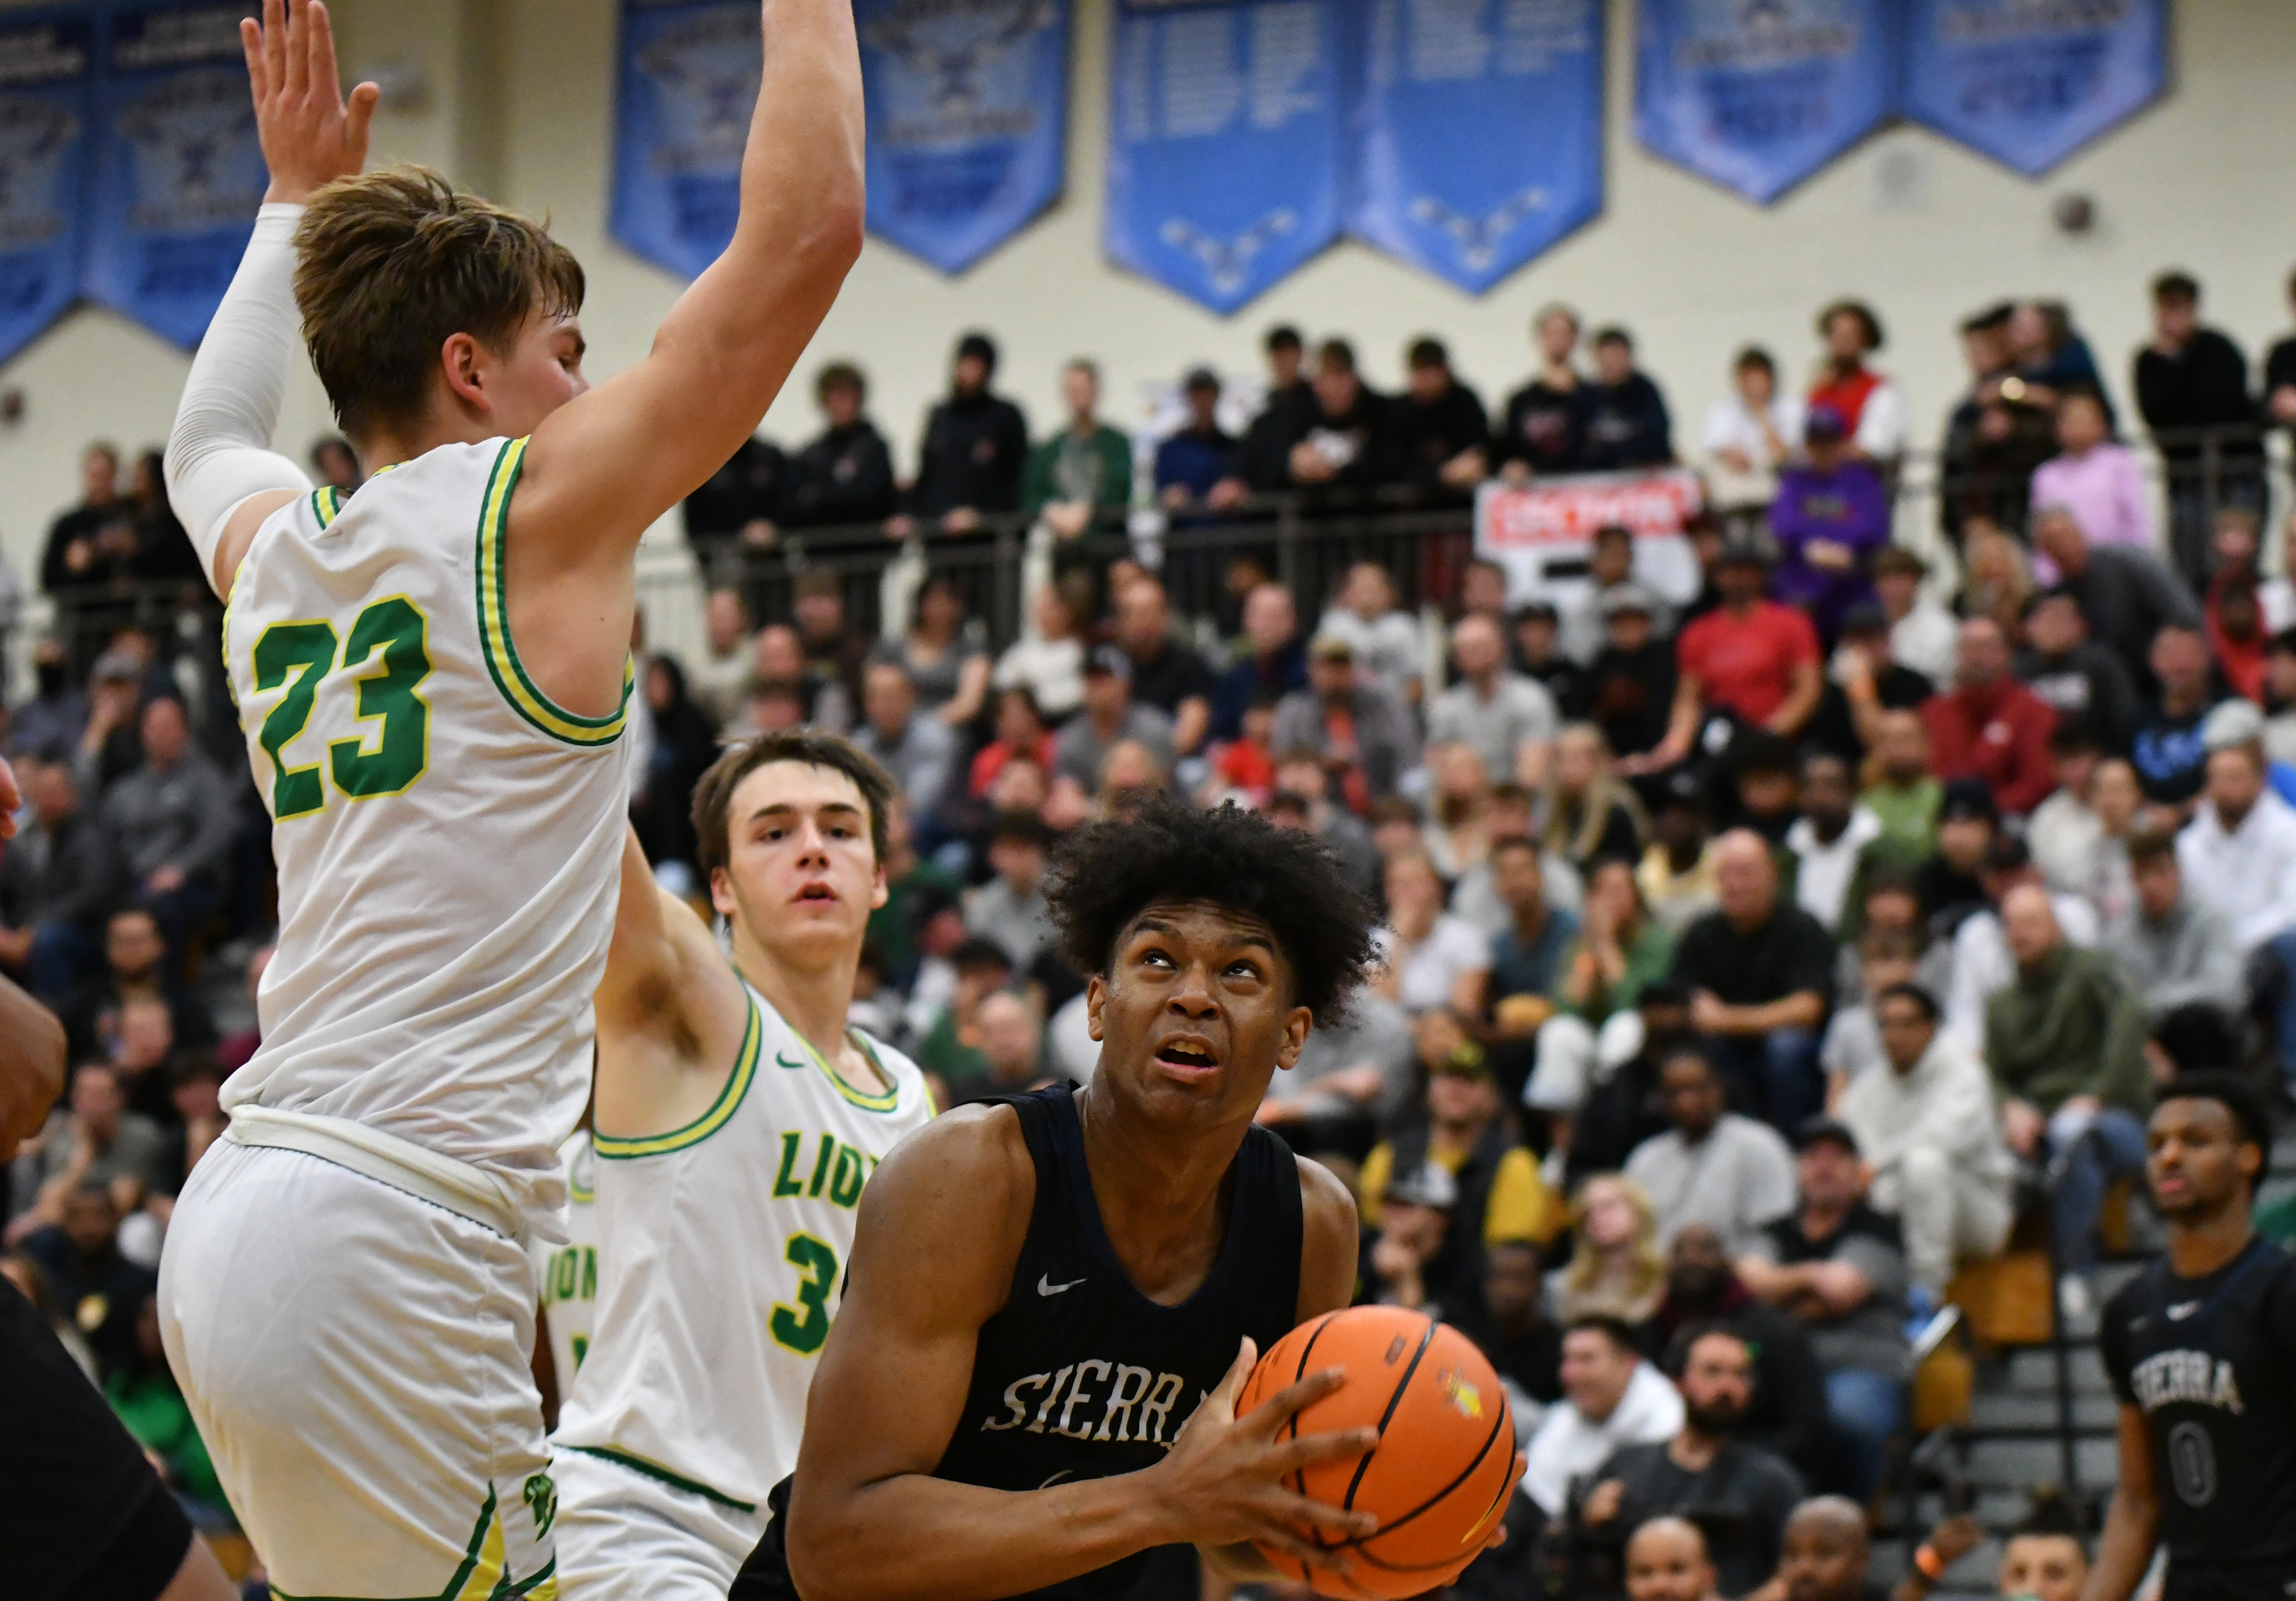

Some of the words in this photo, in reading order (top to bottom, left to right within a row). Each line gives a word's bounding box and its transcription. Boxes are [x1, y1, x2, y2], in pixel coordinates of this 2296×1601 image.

[251, 593, 436, 824] 23
[771, 1130, 882, 1210] LIO
[767, 1229, 839, 1358] 3
